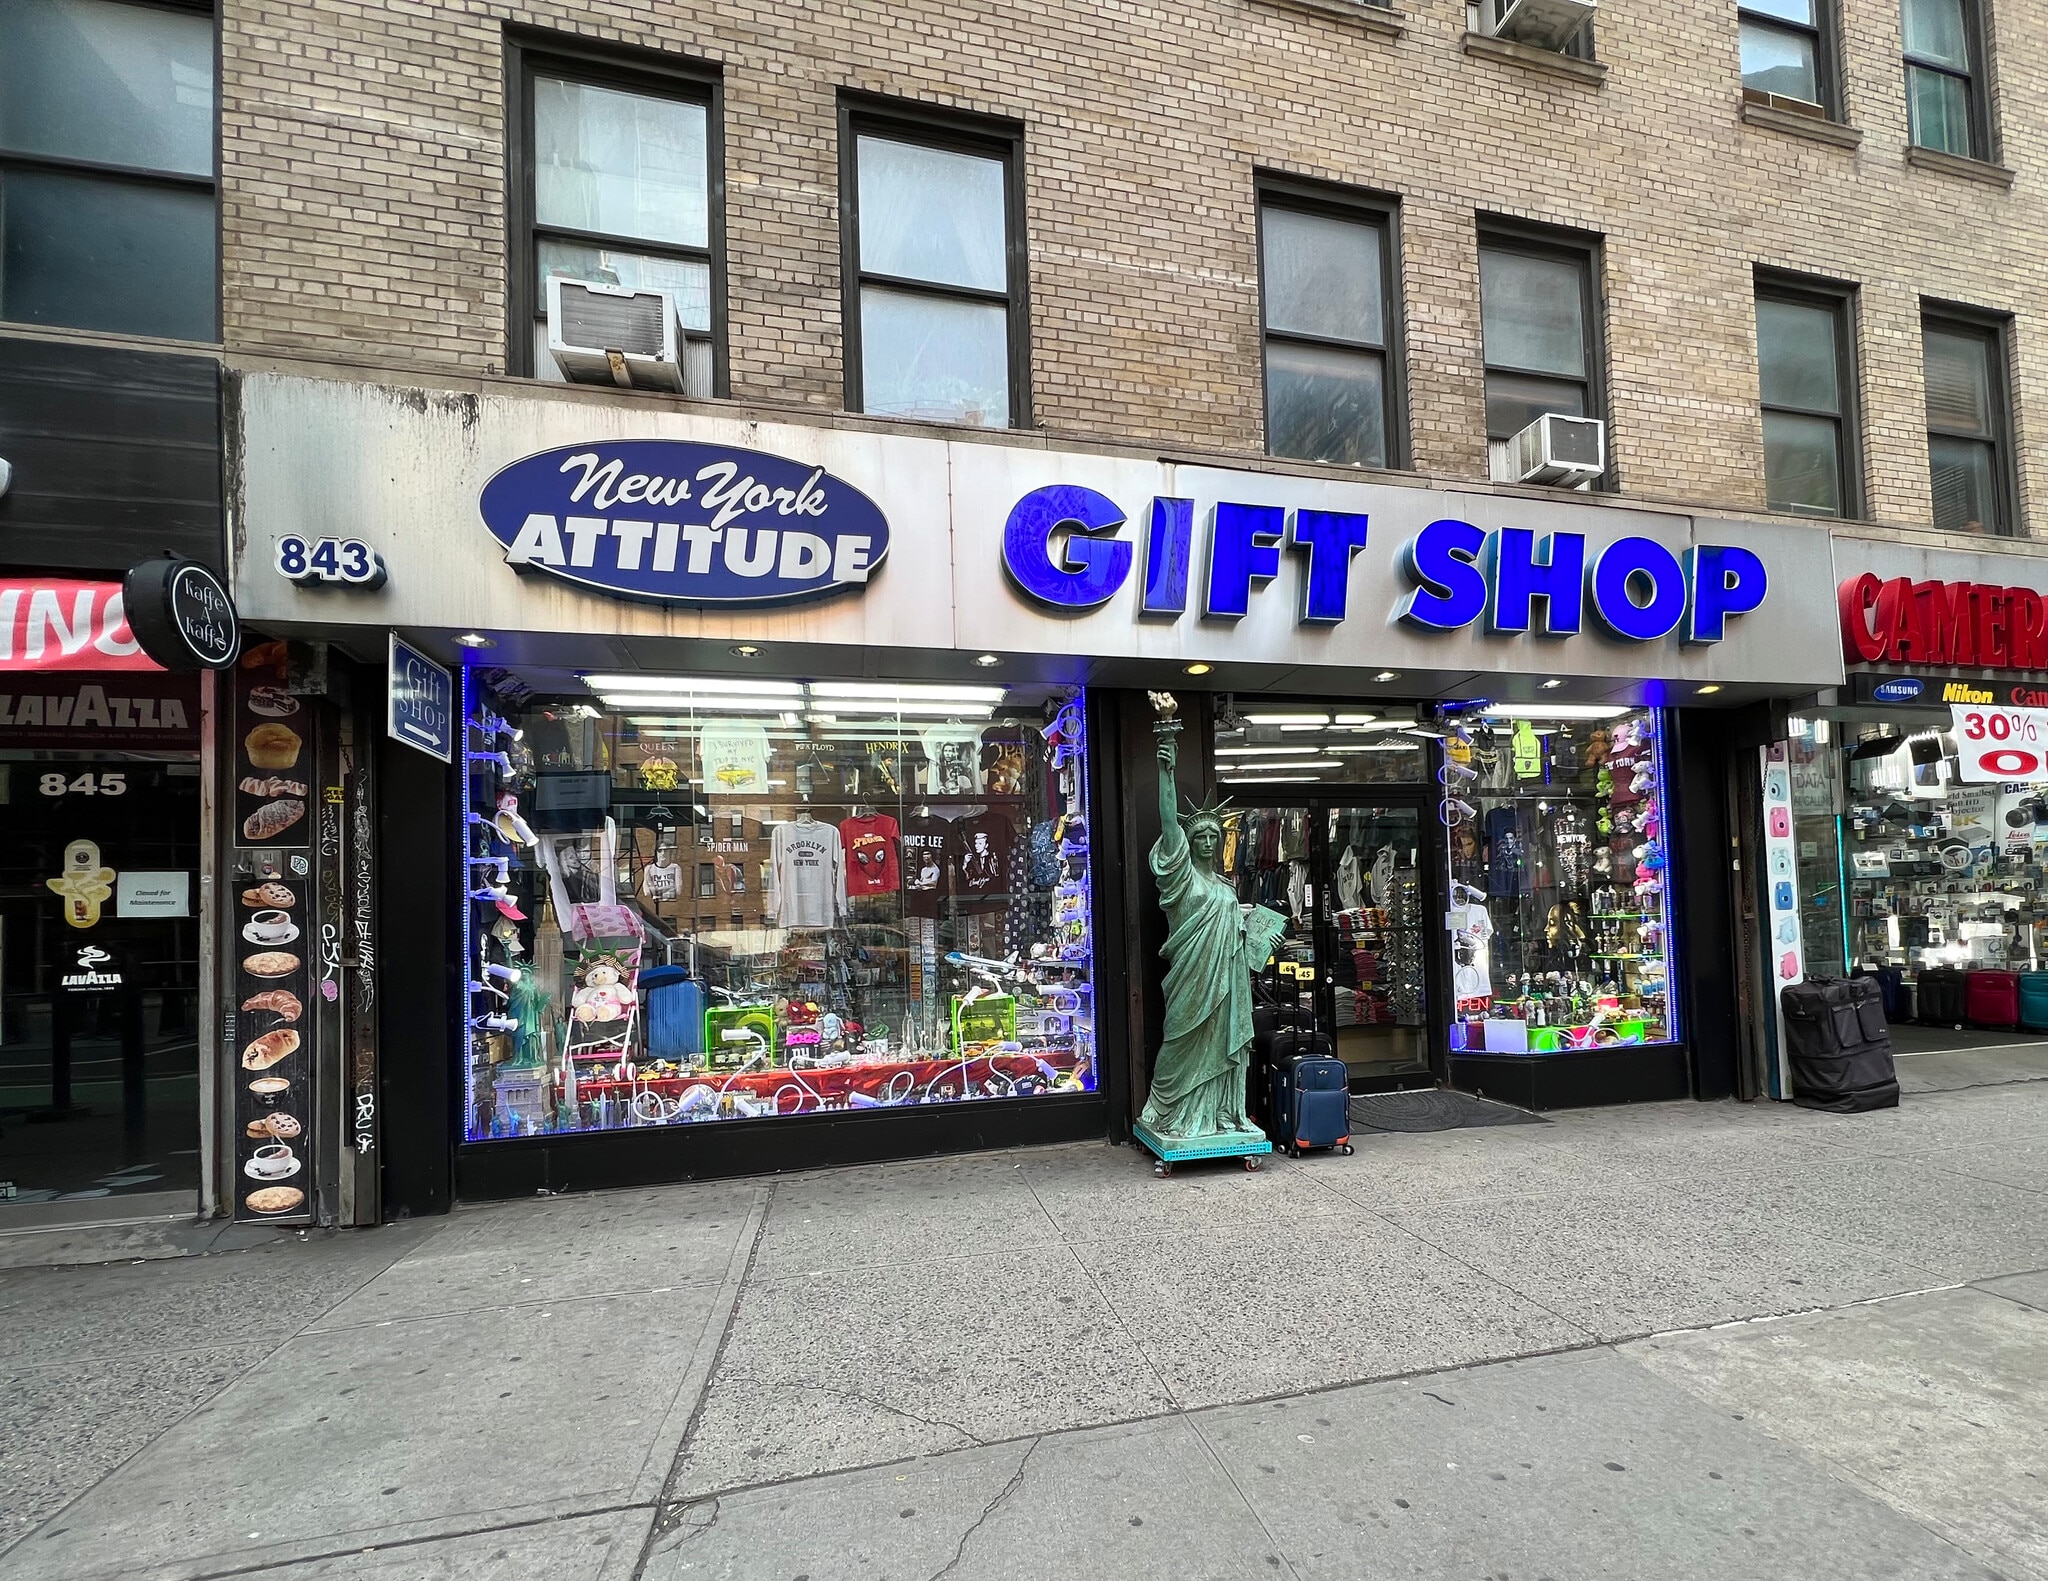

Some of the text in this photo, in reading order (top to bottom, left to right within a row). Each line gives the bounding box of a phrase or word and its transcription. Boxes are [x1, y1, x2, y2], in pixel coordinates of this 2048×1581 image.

[559, 453, 829, 531] New York
[505, 513, 872, 583] ATTITUDE
[278, 536, 371, 579] 843
[1001, 484, 1769, 647] GIFT SHOP
[184, 577, 225, 613] Kaffe
[1852, 571, 2048, 670] CAMER
[407, 657, 442, 707] Gift
[1880, 684, 1919, 696] SAMSUNG
[1942, 682, 1994, 704] Nikon
[400, 694, 446, 732] SHOP
[1964, 712, 2038, 742] 30%
[639, 741, 676, 755] QUEEN
[718, 738, 754, 748] SURVIVED
[811, 742, 835, 753] FLOYD
[865, 741, 910, 755] HENDRX
[714, 757, 729, 765] TRIP
[39, 773, 128, 796] 845
[1796, 772, 1826, 789] DATA
[1961, 788, 1995, 799] Smallest
[1950, 806, 1986, 817] ojector
[903, 835, 944, 849] RUCE LEE
[2005, 830, 2031, 840] Leica
[706, 842, 749, 853] SPIDER-MAN
[785, 840, 828, 854] BROOKLYN
[159, 889, 172, 897] for
[1323, 892, 1331, 919] PULL
[61, 970, 122, 986] LAVAZZA
